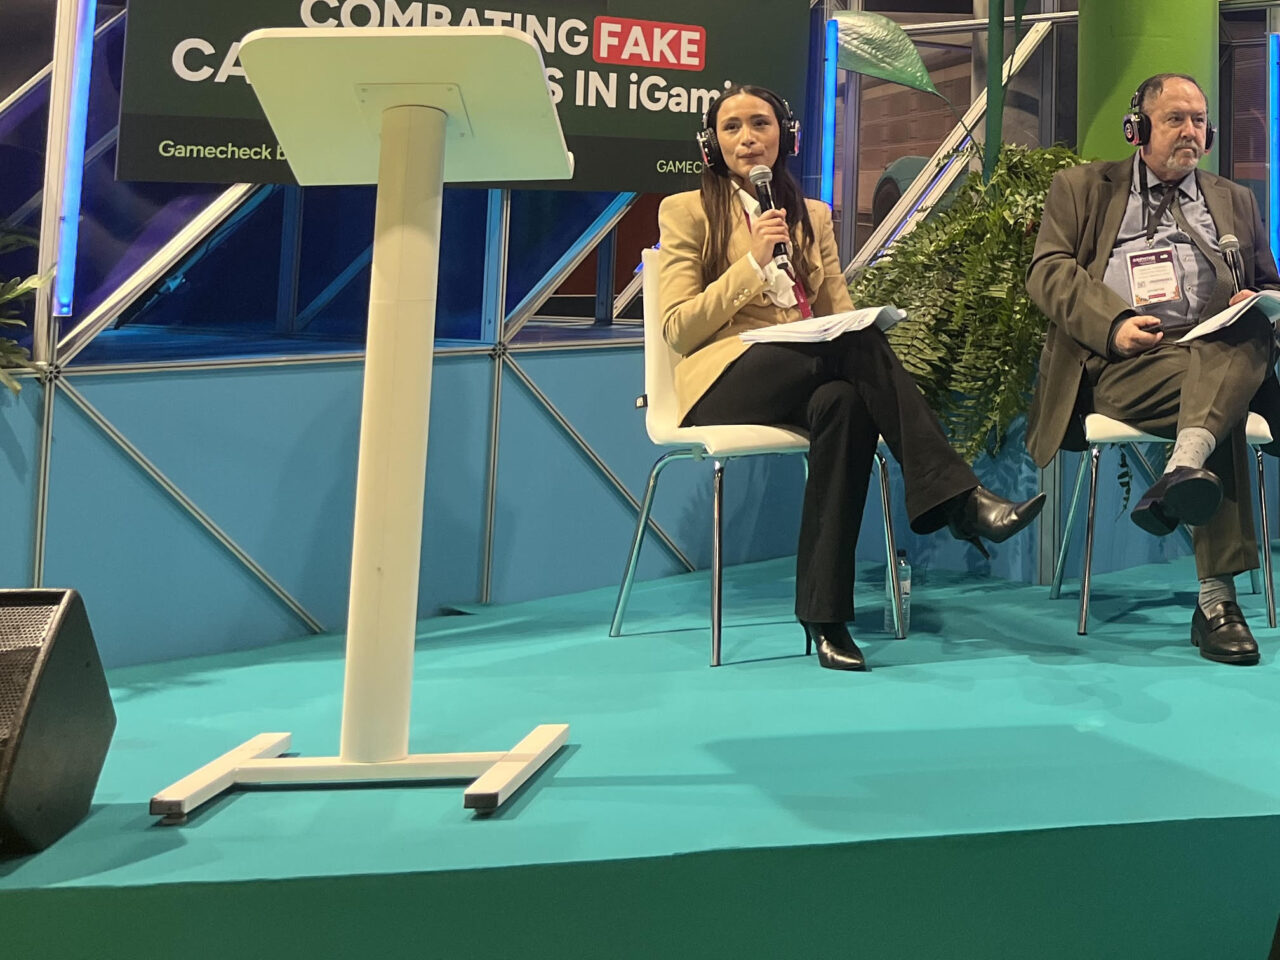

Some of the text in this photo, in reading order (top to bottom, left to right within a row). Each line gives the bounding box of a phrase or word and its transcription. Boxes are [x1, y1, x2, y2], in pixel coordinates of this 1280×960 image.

[600, 22, 701, 66] FAKE
[575, 70, 618, 108] IN
[158, 140, 272, 160] Gamecheck
[656, 159, 704, 174] GAMEC
